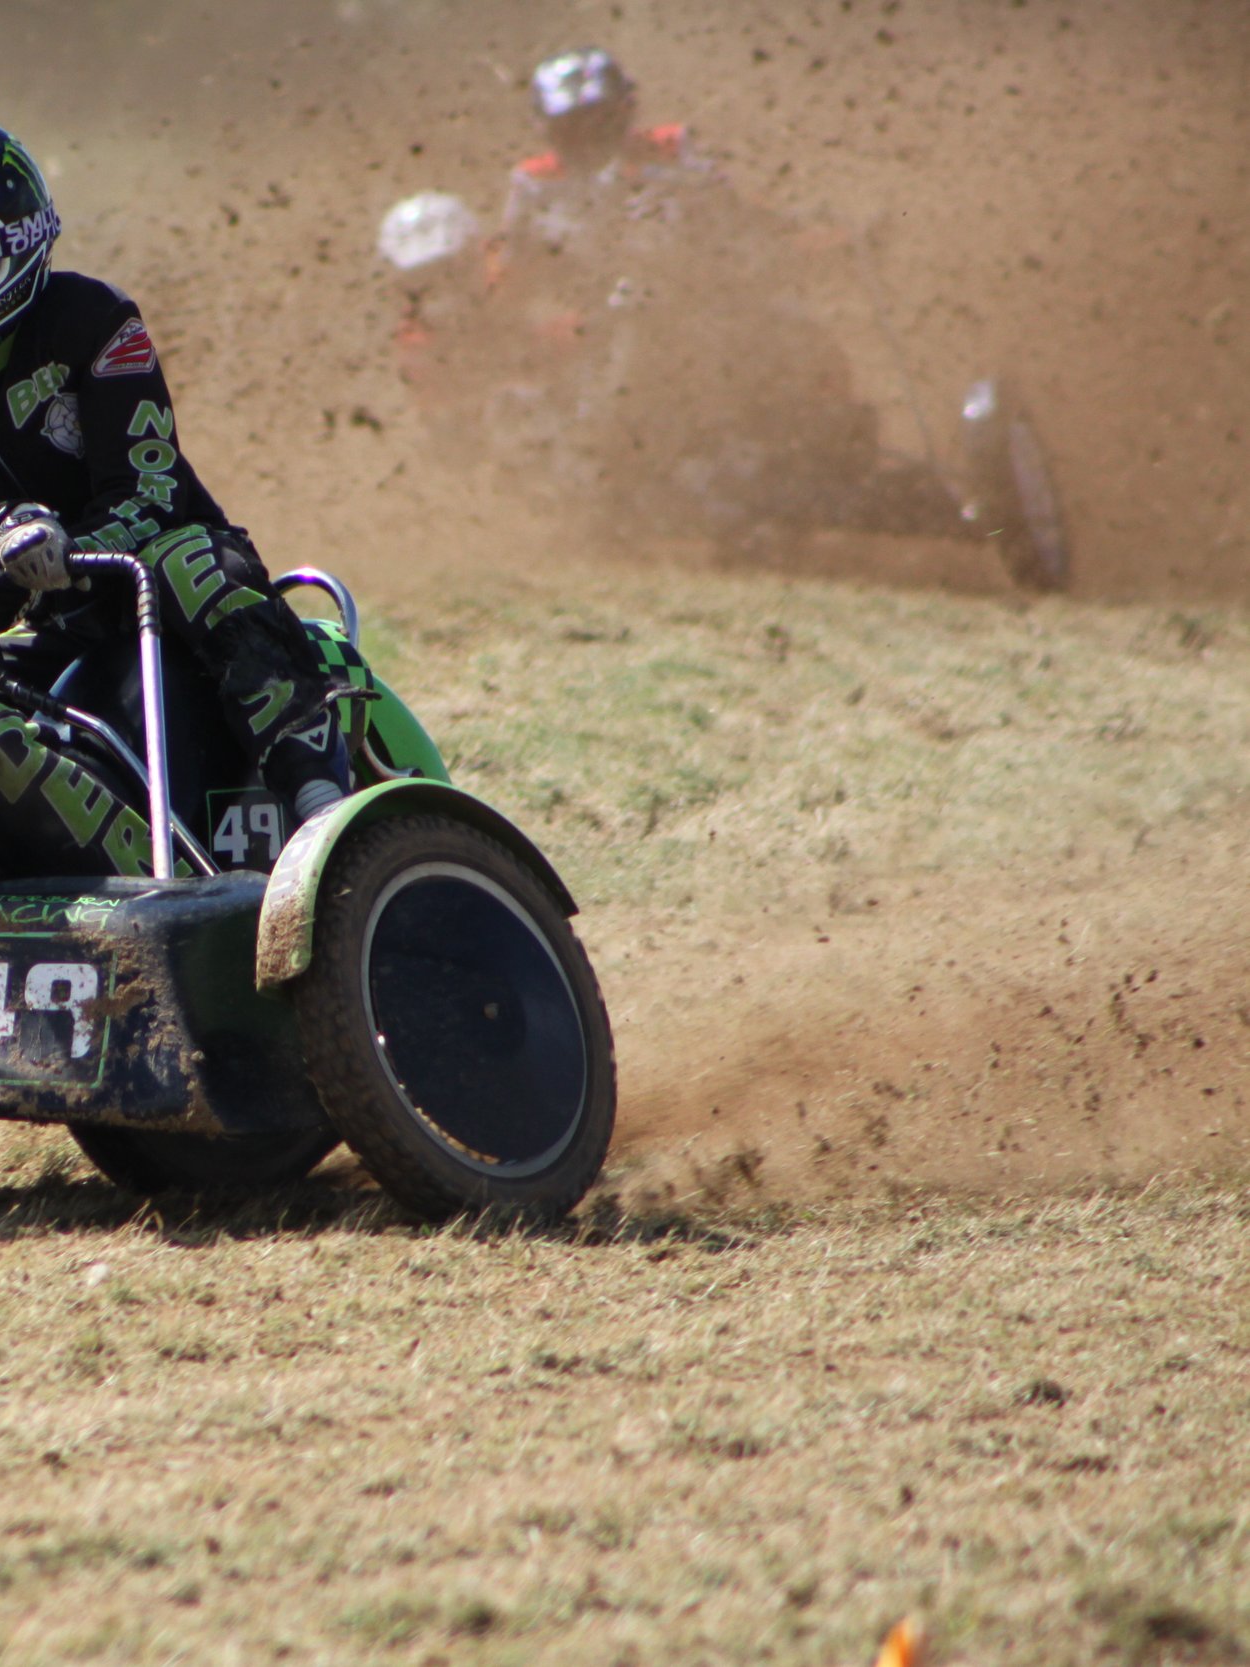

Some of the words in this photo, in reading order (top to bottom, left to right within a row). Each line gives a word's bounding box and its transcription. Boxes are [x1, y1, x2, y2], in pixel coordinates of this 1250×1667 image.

[5, 205, 55, 243] SMIT
[11, 214, 63, 256] OPTIC
[214, 803, 282, 863] 49
